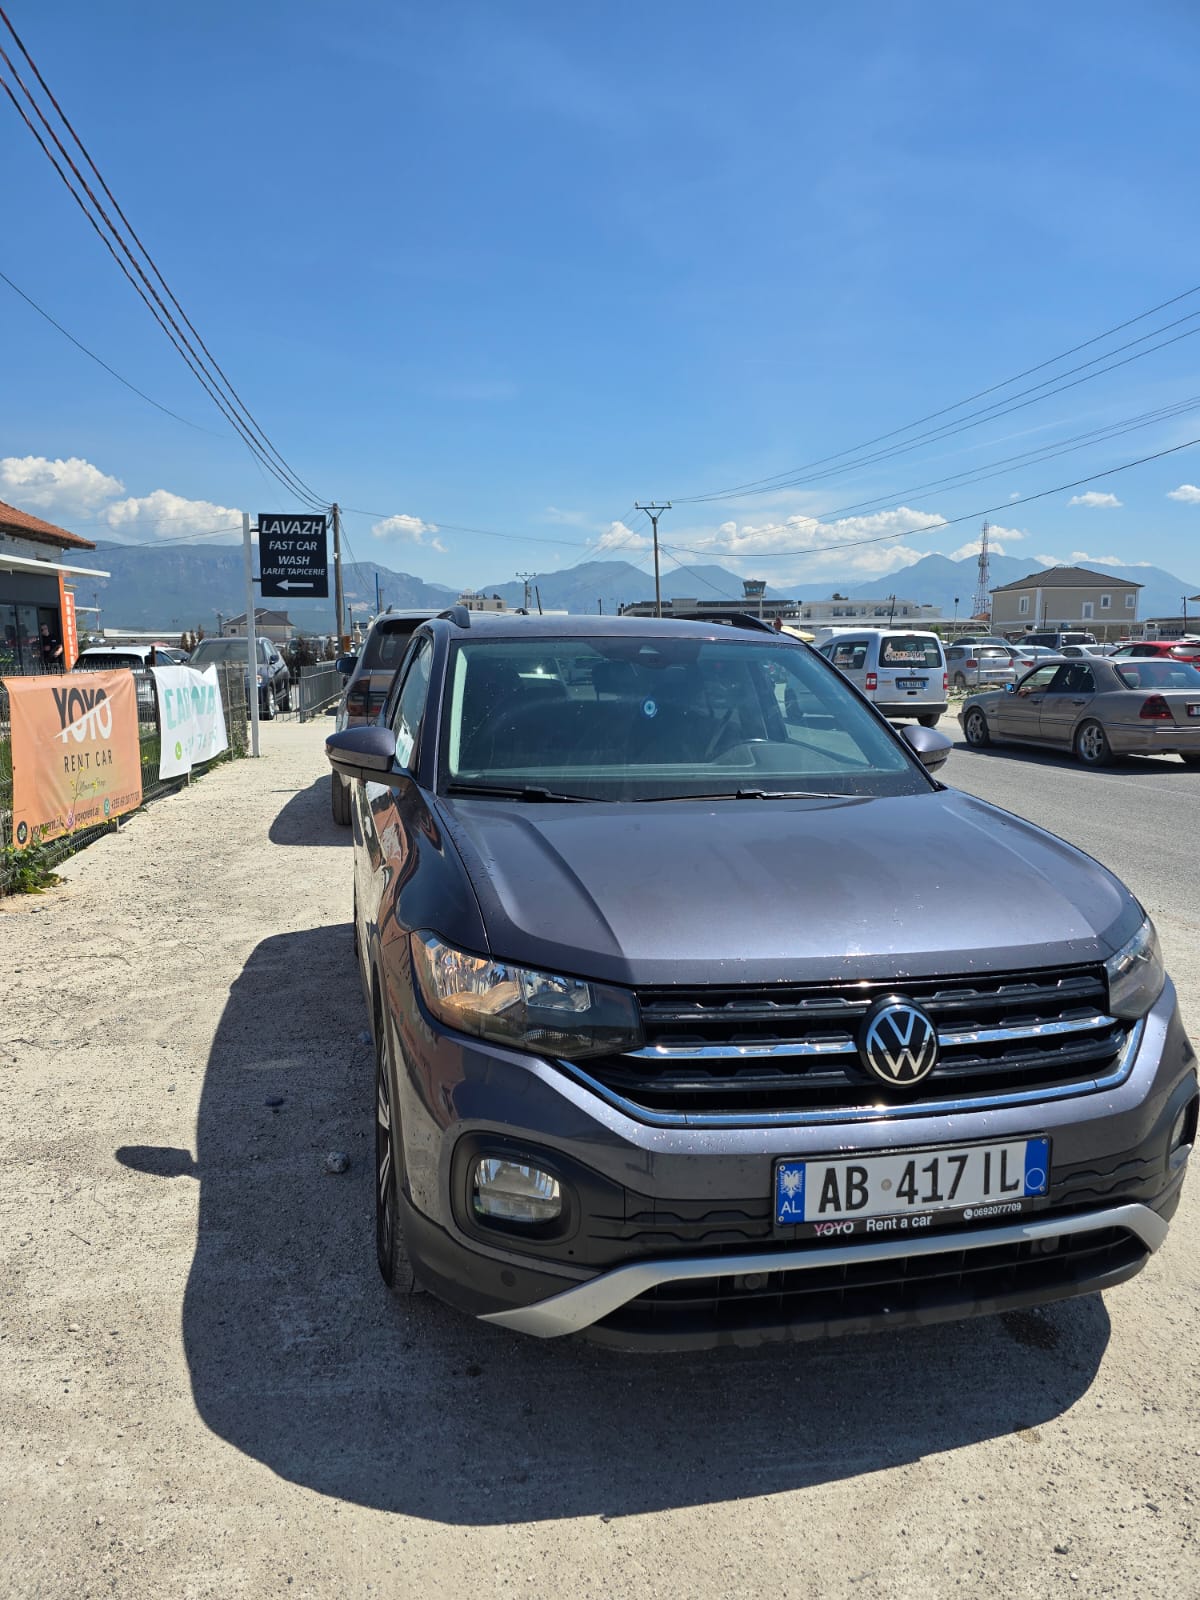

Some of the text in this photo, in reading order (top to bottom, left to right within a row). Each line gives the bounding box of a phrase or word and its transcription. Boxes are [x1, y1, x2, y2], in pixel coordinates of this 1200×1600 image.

[262, 520, 323, 535] LAVAZH
[269, 541, 318, 551] FAST CAR
[278, 555, 310, 565] WASH
[287, 568, 326, 576] TAPICERIE
[52, 687, 113, 743] YOYO
[64, 749, 113, 773] RENT CAR
[818, 1149, 1020, 1213] AB 417 IL
[780, 1200, 801, 1215] AL
[973, 1202, 1022, 1217] 0692077709
[814, 1215, 933, 1236] YOYO Rent a car
